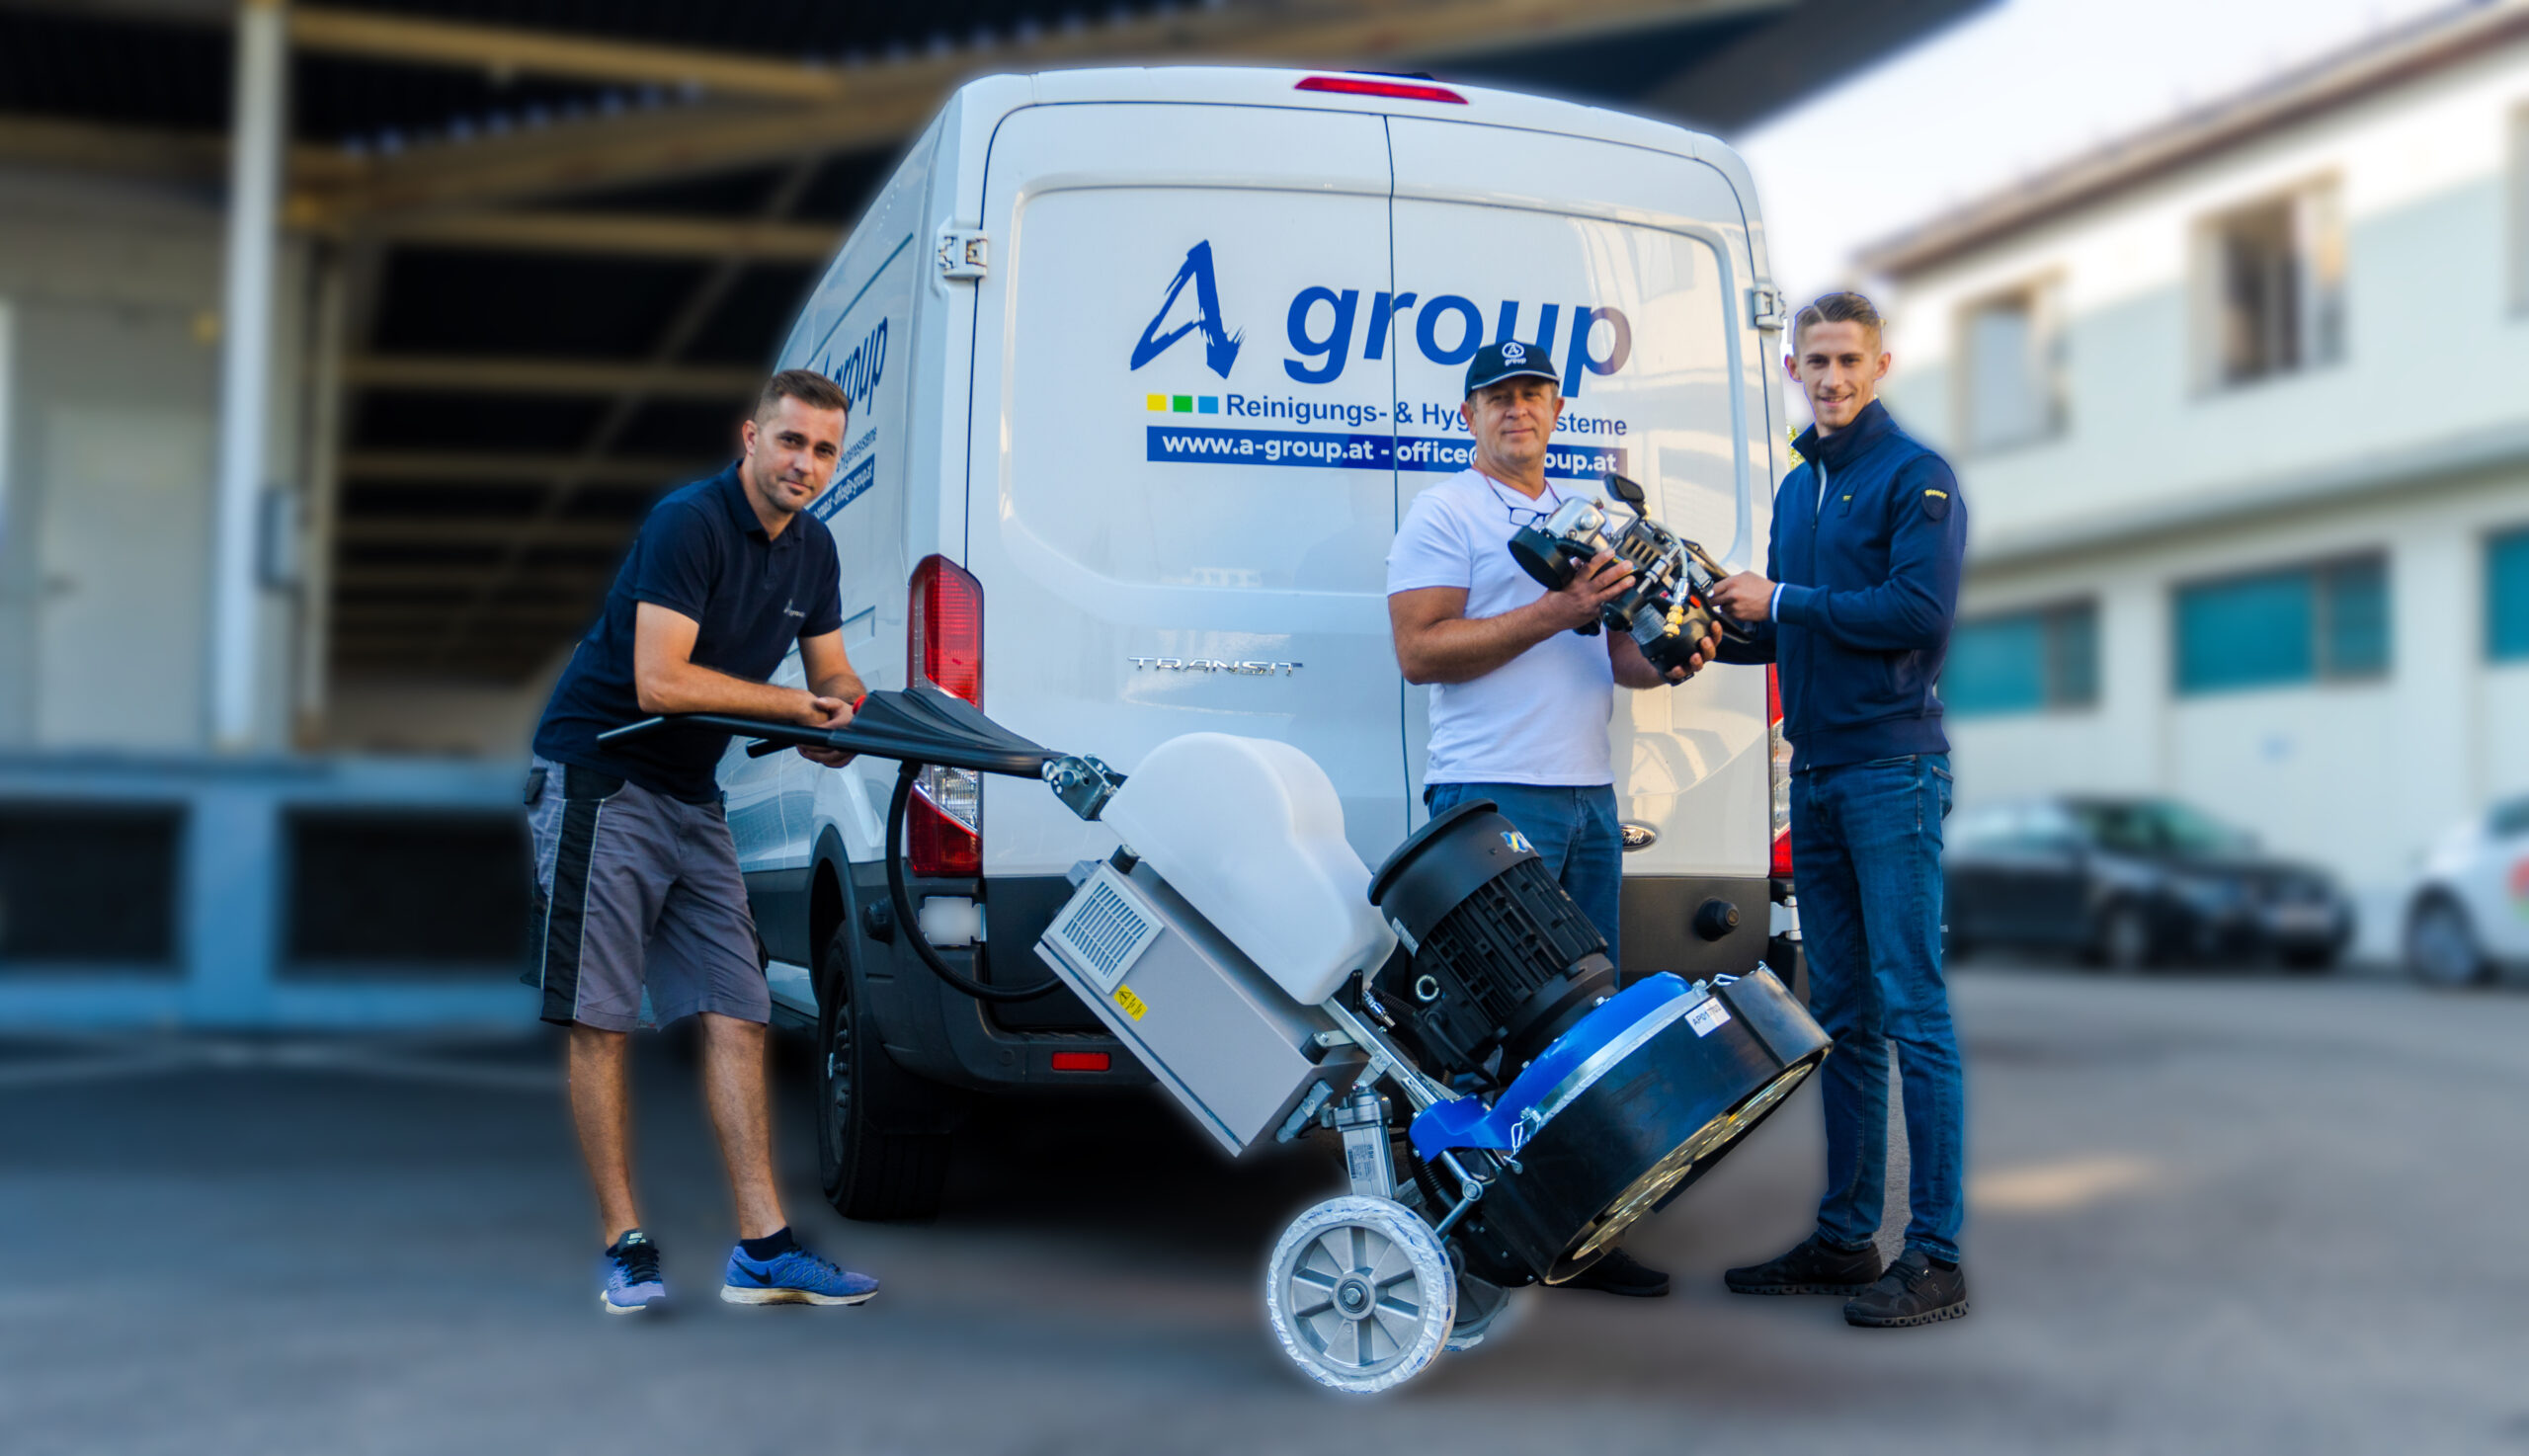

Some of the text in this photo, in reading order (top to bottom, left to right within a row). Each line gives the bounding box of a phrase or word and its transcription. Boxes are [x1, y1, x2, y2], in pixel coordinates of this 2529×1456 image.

[1130, 239, 1632, 398] A group
[1505, 358, 1526, 366] group
[1226, 393, 1388, 427] Reinigungs-
[1395, 401, 1414, 424] &
[1162, 435, 1374, 463] www.a-group.at
[1128, 656, 1304, 677] TRANSIT
[1621, 831, 1647, 846] ord
